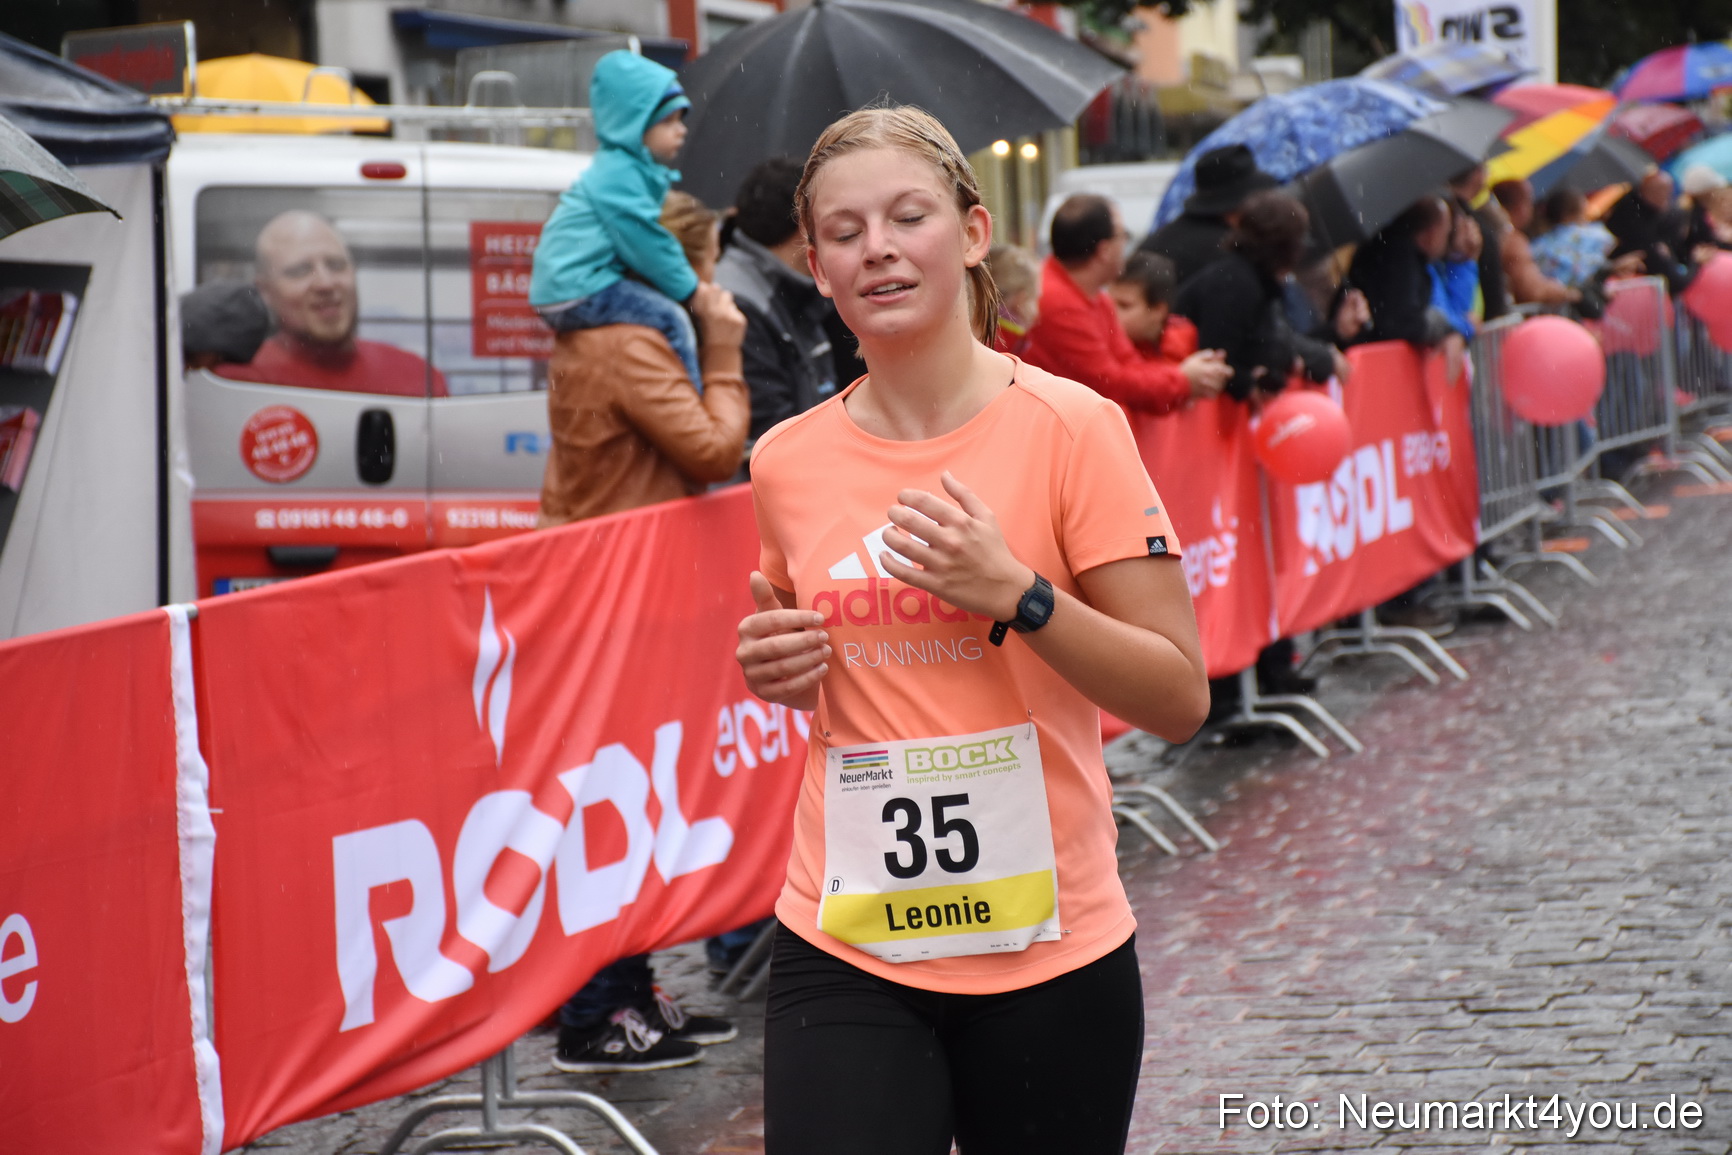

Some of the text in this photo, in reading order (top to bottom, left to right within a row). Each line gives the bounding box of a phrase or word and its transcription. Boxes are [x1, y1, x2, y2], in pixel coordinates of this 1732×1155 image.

[485, 234, 539, 255] HEIZ
[486, 268, 532, 294] BÄD
[501, 508, 539, 529] Neu
[812, 577, 995, 628] adida
[843, 636, 983, 669] RUNNING
[905, 735, 1019, 775] BOCK
[839, 769, 894, 784] NeuerMarkt
[906, 762, 1022, 785] inspired by smart concepts
[881, 793, 980, 880] 35
[885, 895, 992, 932] Leonie
